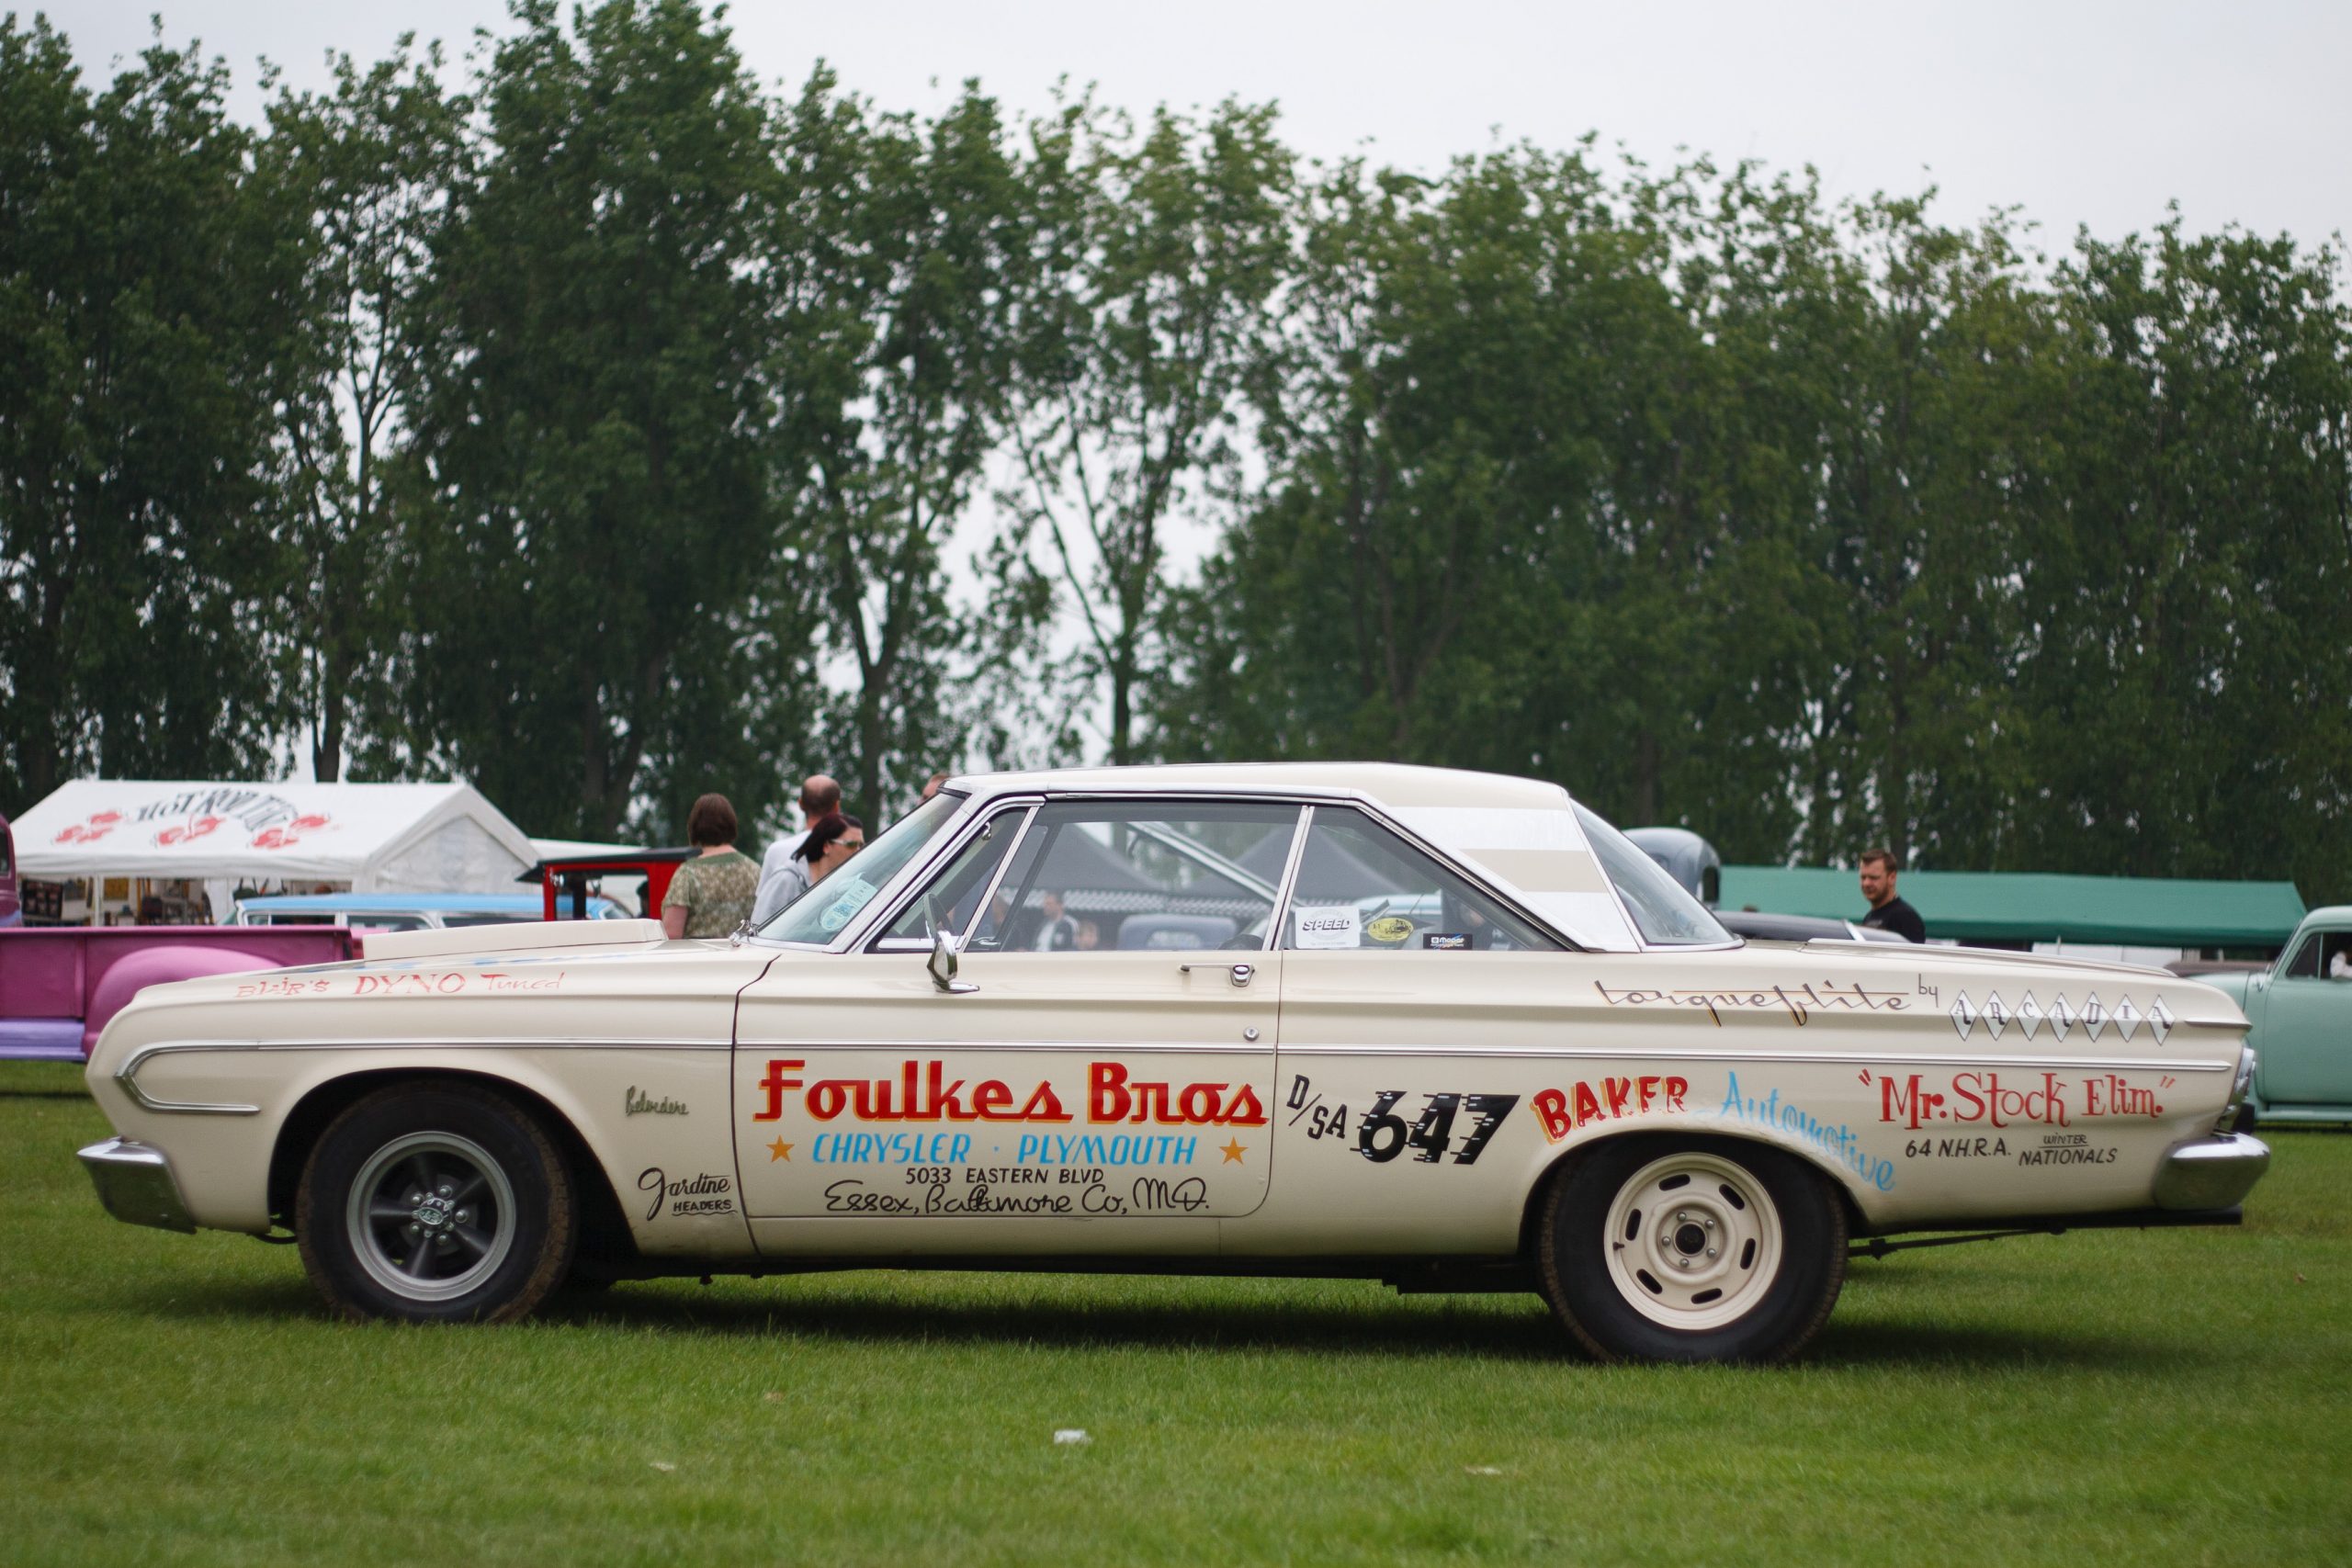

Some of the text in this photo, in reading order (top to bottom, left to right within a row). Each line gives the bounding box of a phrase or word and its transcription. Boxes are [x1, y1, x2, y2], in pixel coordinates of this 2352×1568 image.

[1302, 919, 1351, 931] SPEED
[353, 972, 467, 995] DYNO
[1917, 973, 1939, 1009] by
[1952, 997, 2173, 1032] ARCADIA
[752, 1059, 1271, 1126] Foulkes Bros
[1350, 1090, 1521, 1166] 647
[1719, 1070, 1896, 1192] Automotive
[811, 1133, 1197, 1167] CHRYSLER PLYMOUTH
[1905, 1137, 2012, 1158] 64 N.H.R.A.
[2018, 1147, 2119, 1167] NATIONALS
[905, 1167, 1105, 1185] 5033 EASTERN BLVD
[673, 1198, 733, 1213] HEADERS
[825, 1179, 921, 1216] Essex,
